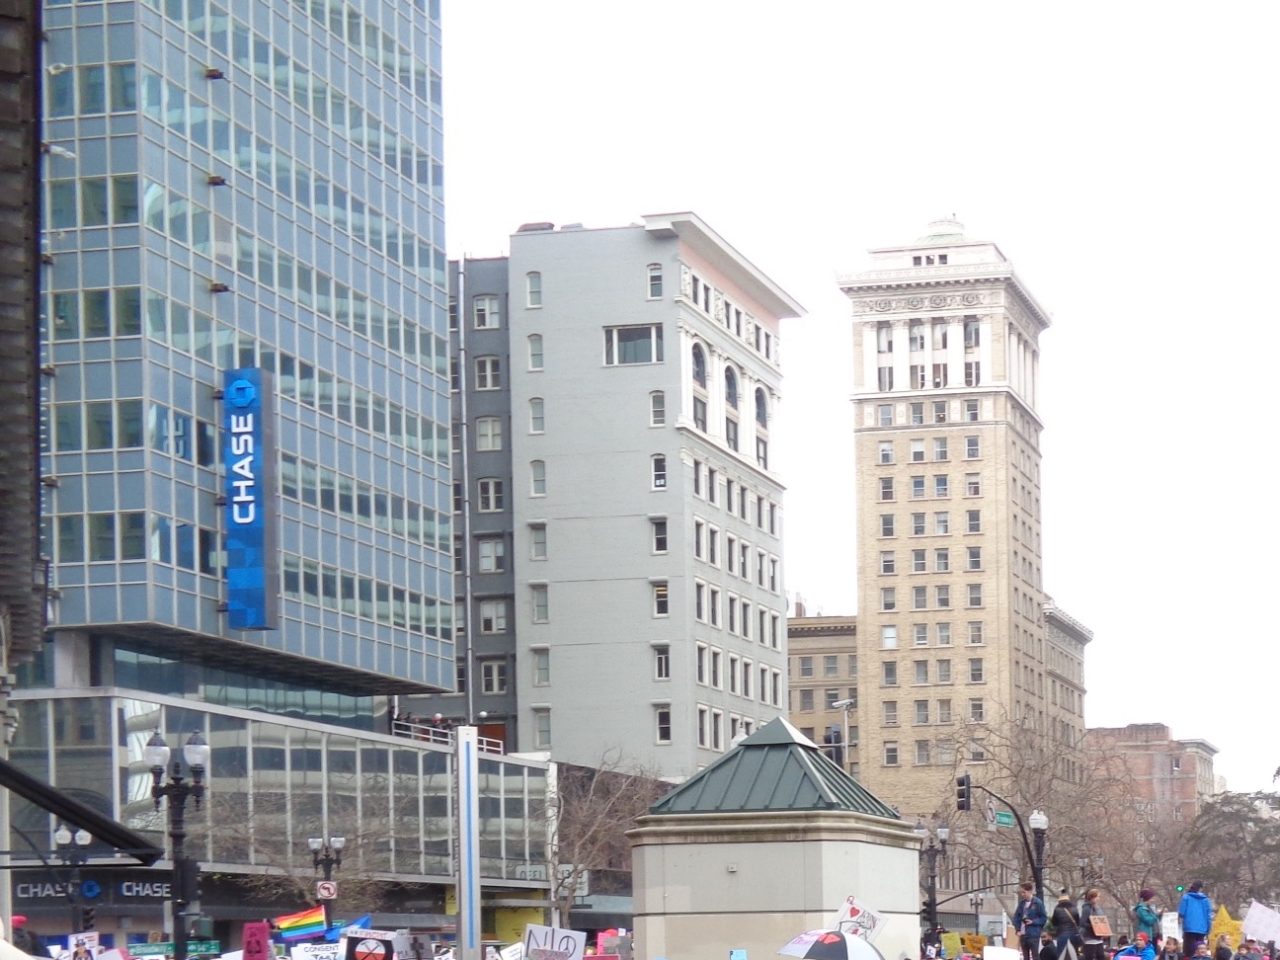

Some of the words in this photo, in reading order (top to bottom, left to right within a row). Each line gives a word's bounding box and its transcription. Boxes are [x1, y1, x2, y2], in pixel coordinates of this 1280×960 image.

[231, 413, 255, 524] CHASE
[122, 881, 171, 897] CHASE
[304, 945, 340, 953] CONSENT
